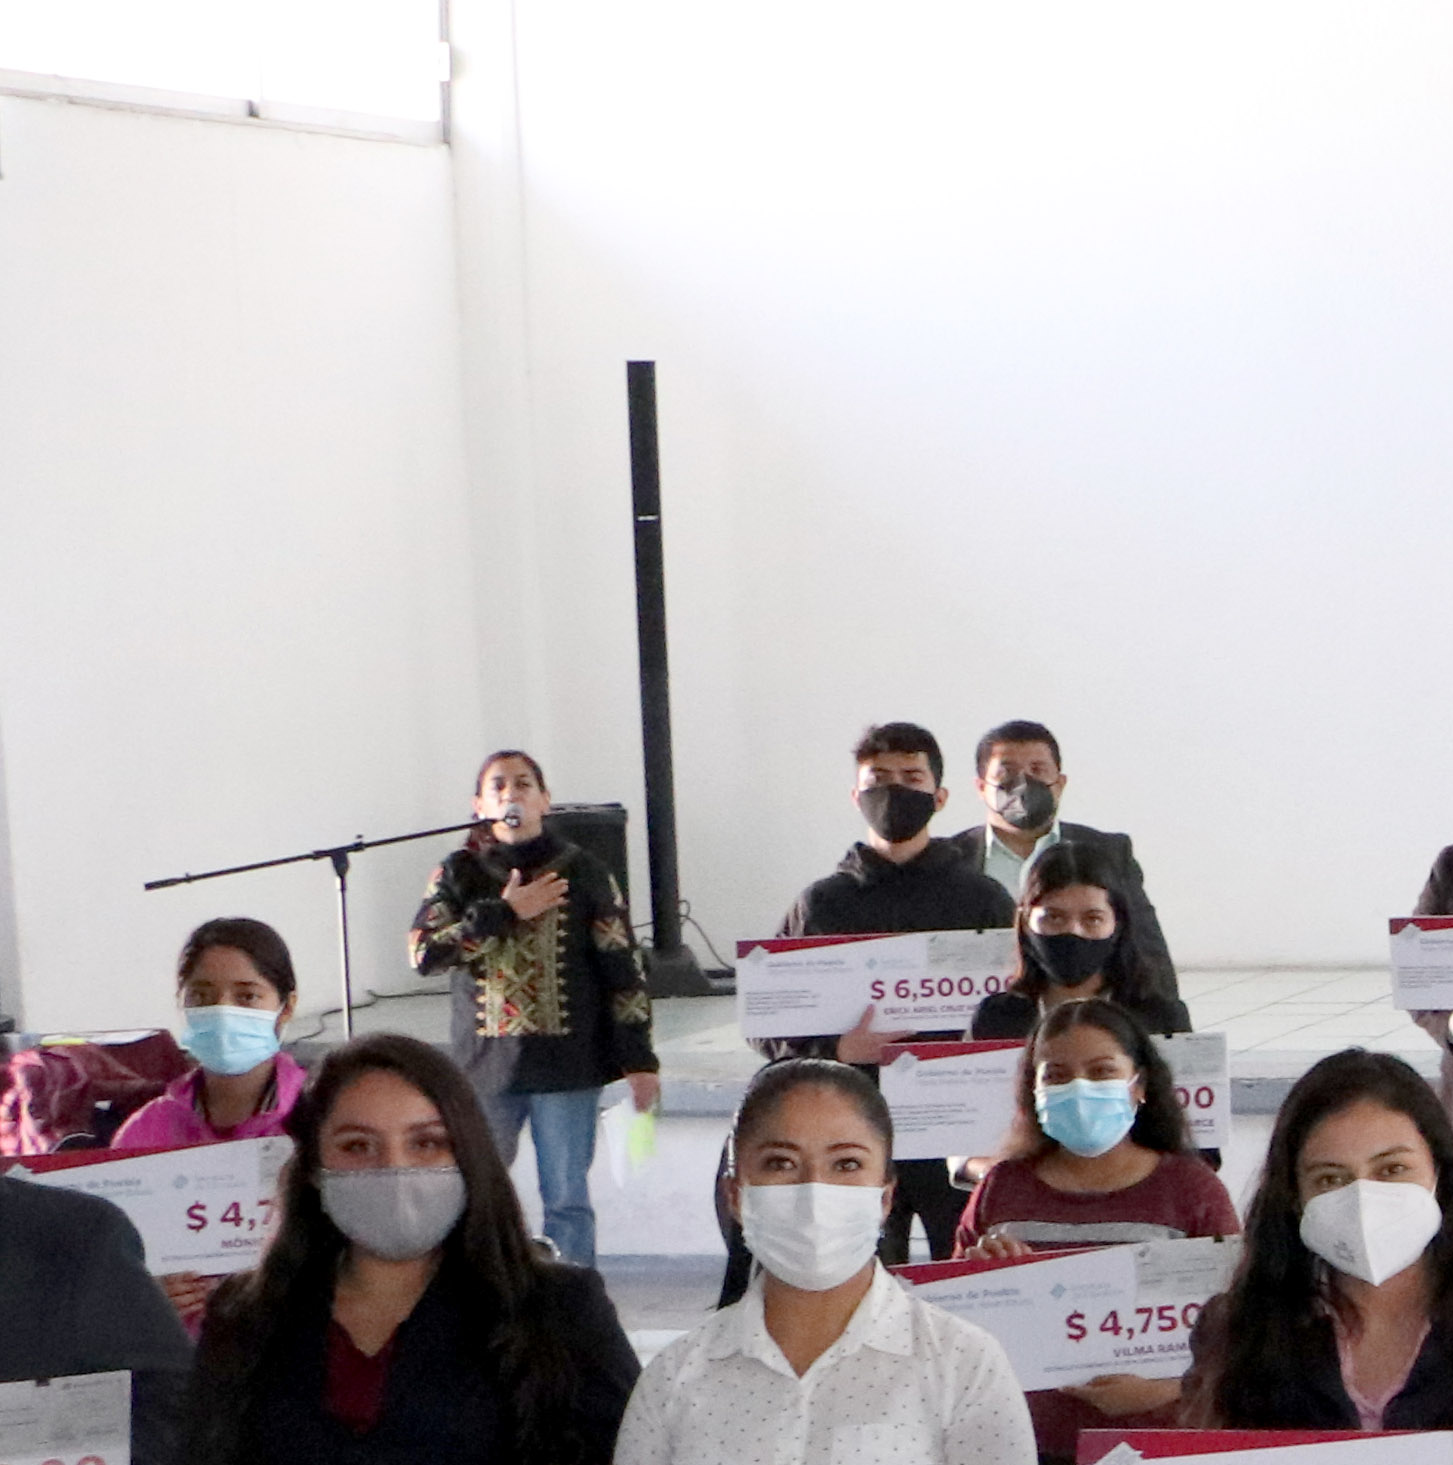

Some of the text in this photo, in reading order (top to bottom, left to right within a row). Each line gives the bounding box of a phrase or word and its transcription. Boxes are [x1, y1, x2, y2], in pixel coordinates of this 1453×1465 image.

[871, 979, 885, 1000] $
[186, 1200, 208, 1232] $
[1065, 1308, 1088, 1343] $
